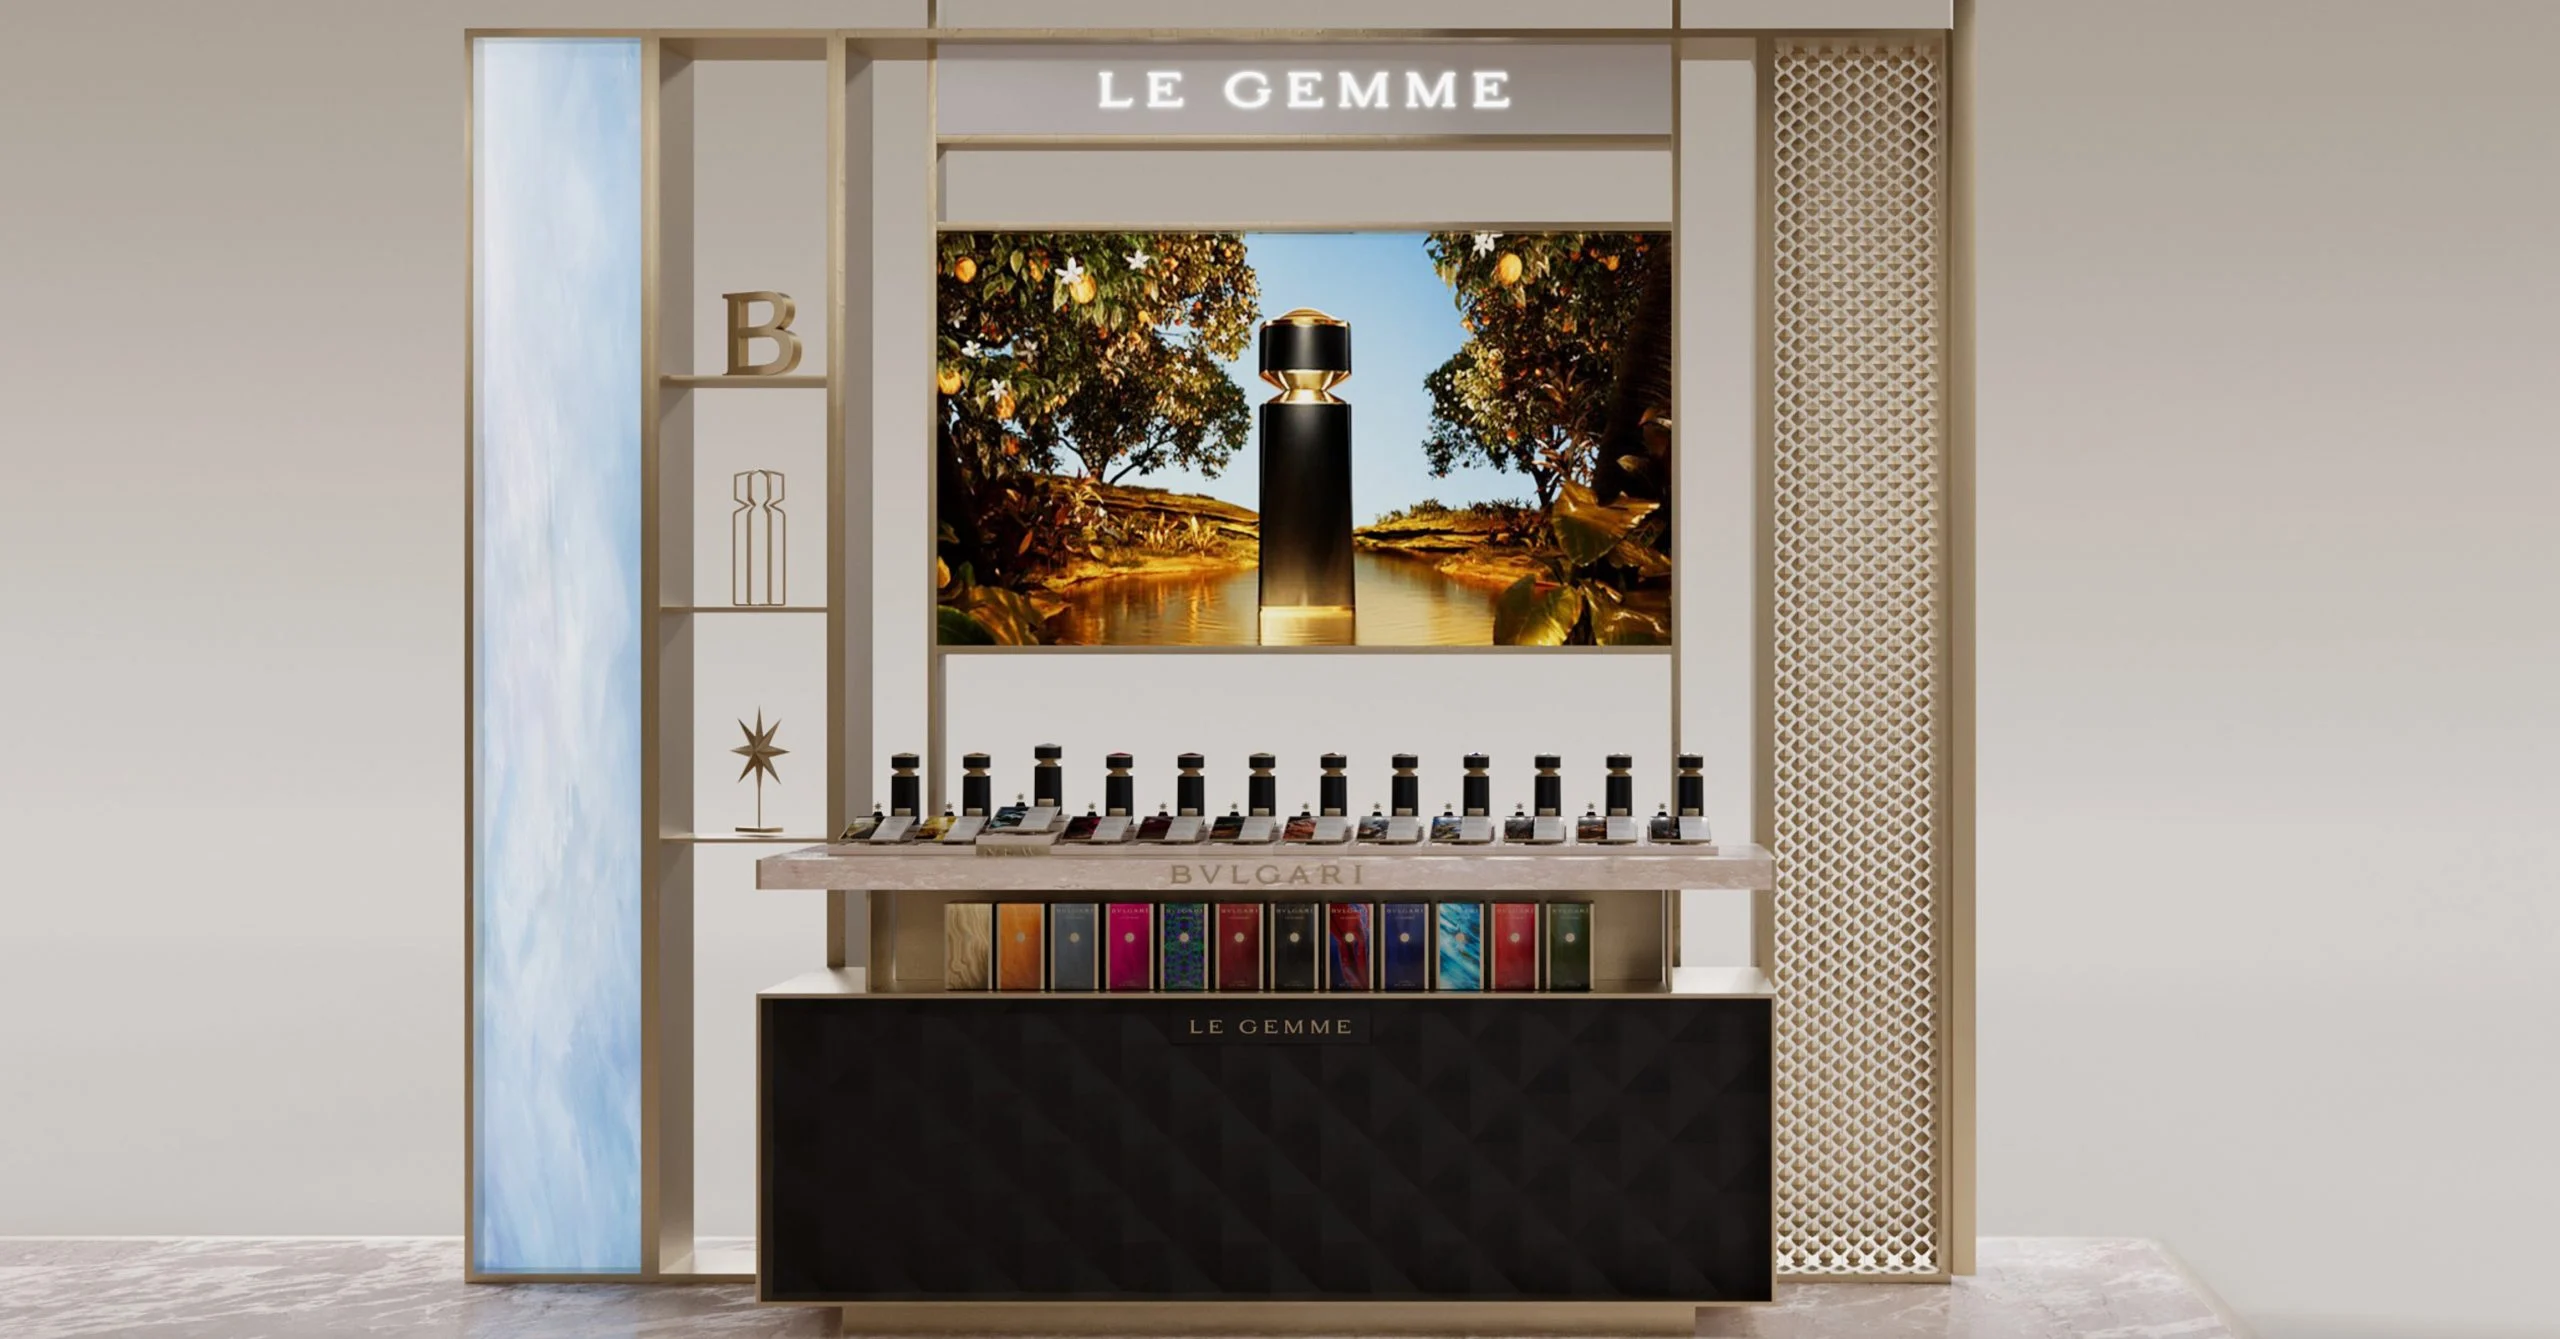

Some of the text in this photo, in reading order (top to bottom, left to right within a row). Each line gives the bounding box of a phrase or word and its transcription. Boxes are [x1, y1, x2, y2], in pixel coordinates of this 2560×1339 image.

[1098, 71, 1511, 109] LE GEMME
[722, 291, 803, 376] B
[985, 846, 1035, 857] NEW
[1170, 864, 1364, 885] BVLGARI
[1189, 1019, 1352, 1035] LE GEMME
